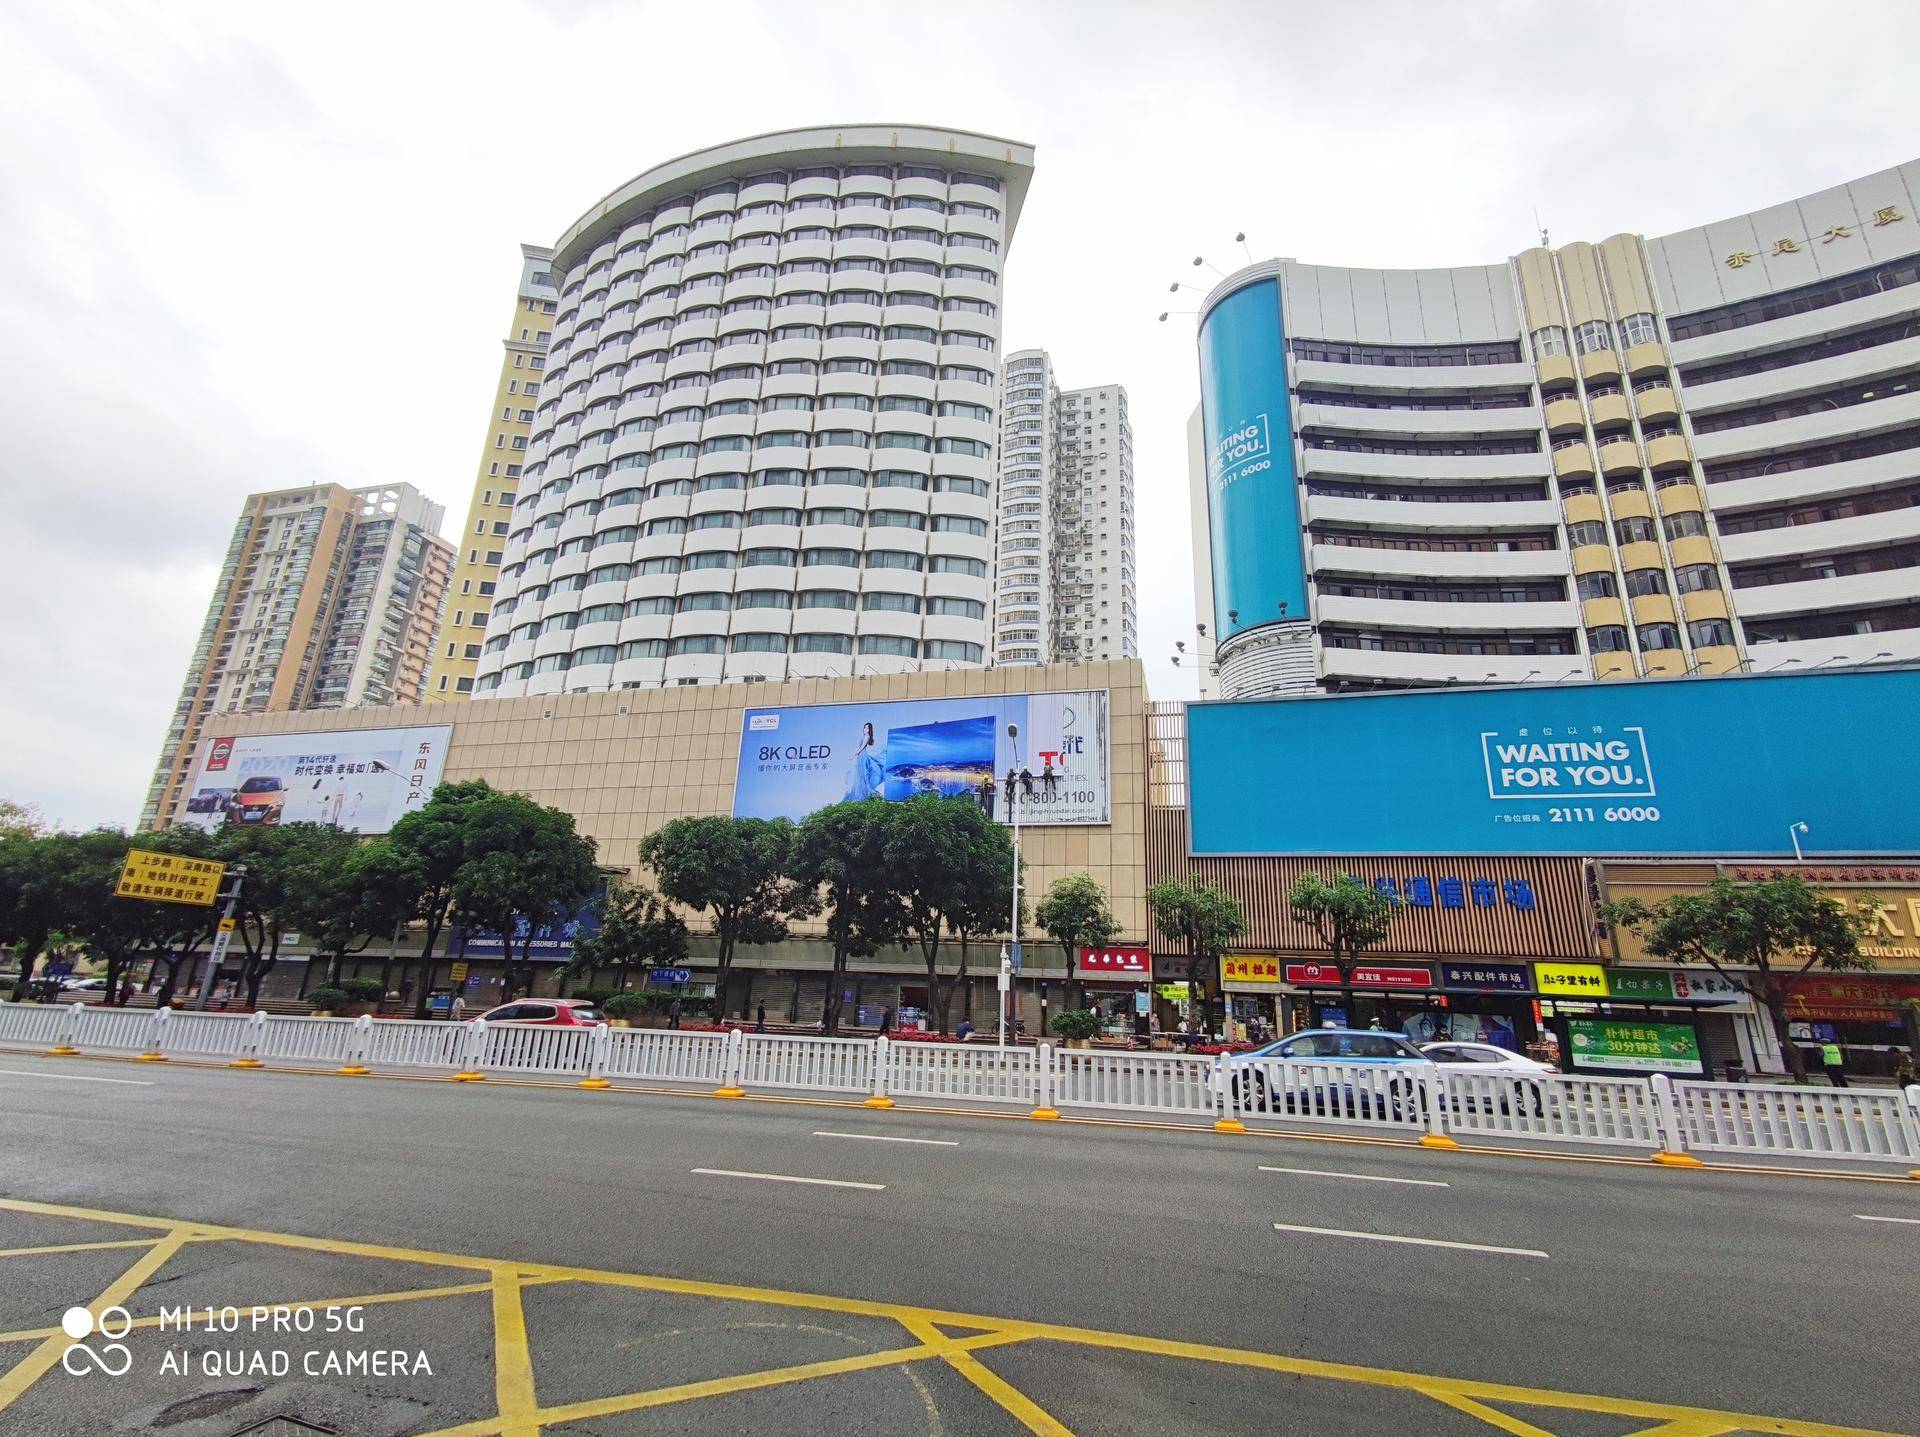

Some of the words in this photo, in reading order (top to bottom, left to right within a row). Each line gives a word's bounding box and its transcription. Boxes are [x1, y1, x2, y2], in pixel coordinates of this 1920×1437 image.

[1211, 425, 1258, 464] AITING
[1226, 439, 1264, 462] YOU.
[1241, 460, 1271, 477] 6000
[1519, 725, 1603, 737] 虚位以待
[758, 746, 781, 761] 8K
[785, 745, 831, 760] QLED
[1038, 751, 1064, 767] T
[1496, 740, 1630, 764] WAITING
[405, 741, 431, 805] 东风日产
[1501, 767, 1560, 787] FOR
[1564, 765, 1645, 786] YOU.
[1548, 807, 1595, 823] 2111
[1604, 806, 1661, 822] 6000
[1350, 876, 1536, 911] 兴通信市场
[517, 940, 558, 948] ACESSORIES
[1450, 970, 1522, 983] 泰兴配件市场
[1605, 1027, 1659, 1041] 朴朴超市
[1607, 1040, 1662, 1054] 30分钟达
